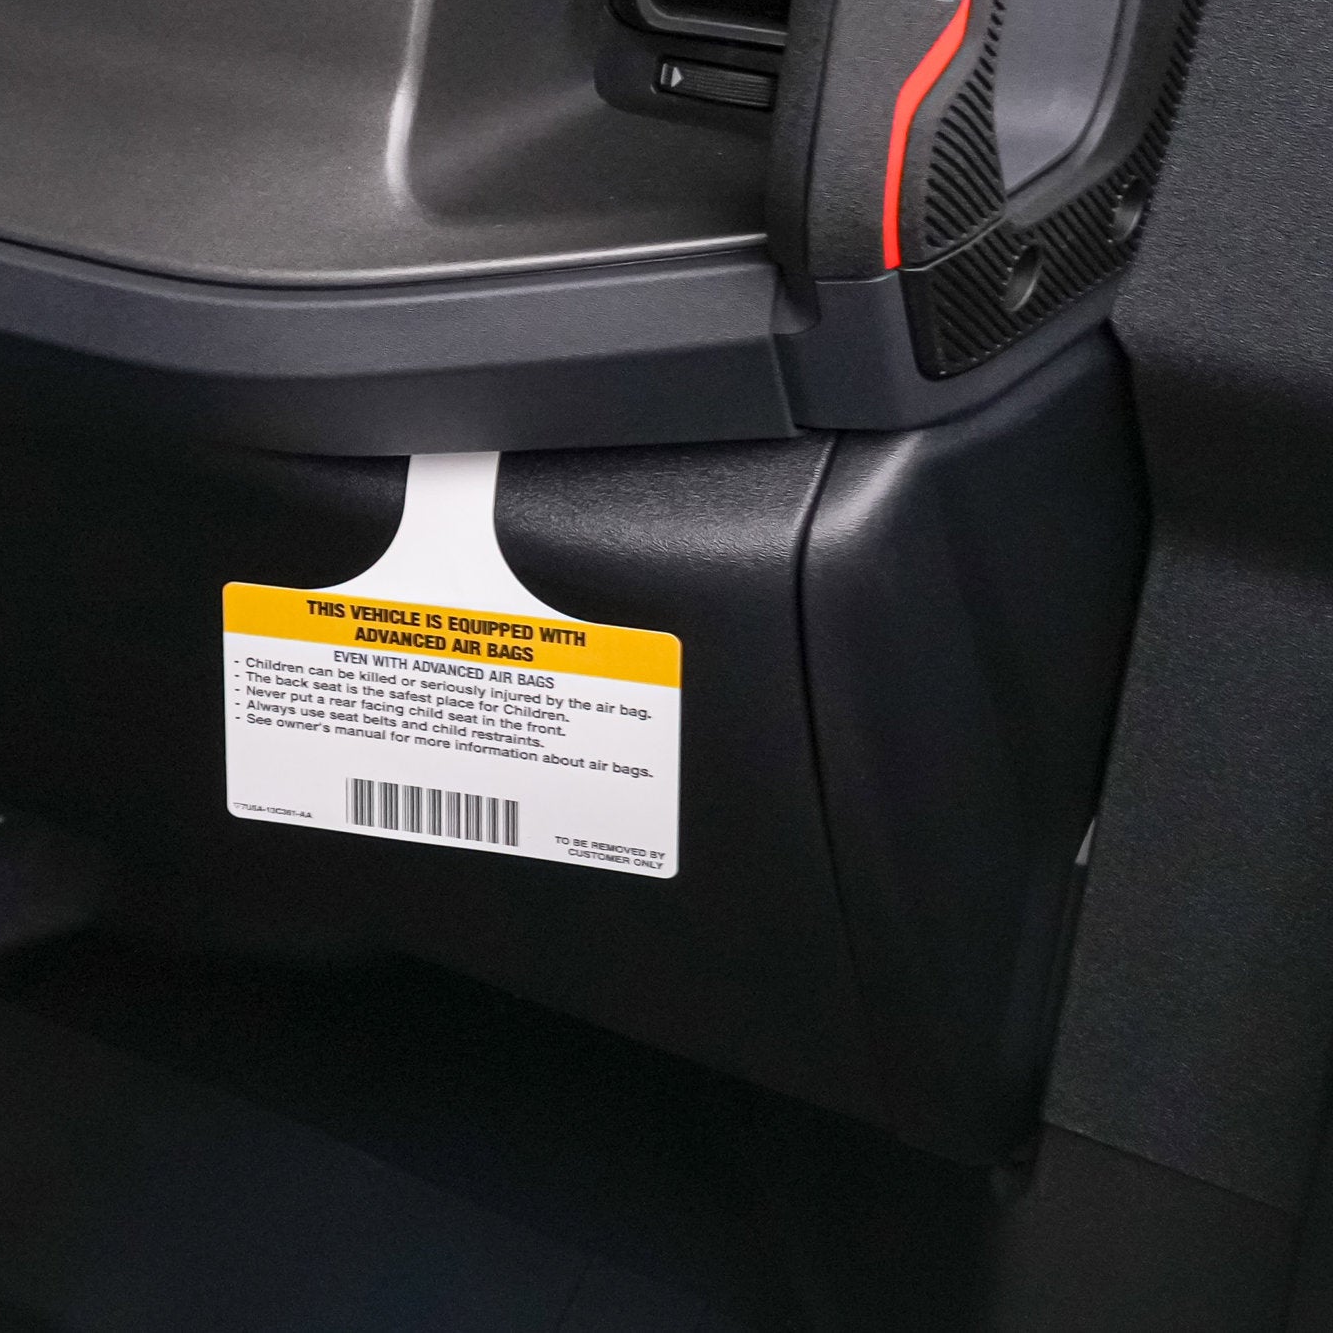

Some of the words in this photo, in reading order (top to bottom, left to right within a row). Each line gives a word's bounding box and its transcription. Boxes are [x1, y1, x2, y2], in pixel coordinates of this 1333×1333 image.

[307, 600, 346, 618] THIS
[351, 605, 420, 626] VEHICLE
[426, 614, 442, 629] IS
[448, 617, 533, 640] EQUIPPED
[540, 627, 586, 646] WITH
[355, 627, 446, 651] ADVANCED
[452, 639, 481, 656] AIR
[487, 643, 534, 662] BAGS
[246, 657, 303, 673] Children
[309, 666, 333, 677] can
[338, 670, 355, 679] be
[360, 671, 397, 684] killed
[401, 676, 416, 686] or
[421, 679, 486, 698] seriously
[491, 687, 541, 704] injured
[547, 695, 563, 709] by
[569, 698, 591, 710] the
[596, 702, 615, 714] air
[620, 705, 651, 720] bag.
[334, 651, 368, 665] EVEN
[373, 655, 407, 669] WITH
[413, 660, 483, 679] ADVANCED
[489, 670, 512, 684] AIR
[518, 674, 554, 689] BAGS
[247, 672, 271, 683] The
[276, 675, 308, 688] back
[313, 680, 342, 692] seat
[347, 683, 357, 694] is
[363, 685, 383, 697] the
[389, 689, 431, 703] safest
[436, 693, 474, 709] place
[479, 700, 498, 712] for
[504, 704, 570, 722] Children.
[247, 686, 286, 699] Never
[291, 692, 312, 703] put
[317, 696, 325, 704] a
[330, 698, 356, 708] rear
[361, 700, 404, 716] facing
[409, 706, 443, 719] child
[448, 712, 478, 725] seat
[483, 715, 495, 726] in
[500, 718, 522, 730] the
[527, 722, 566, 736] front.
[247, 700, 295, 715] Always
[301, 708, 325, 718] use
[330, 710, 358, 723] seat
[363, 714, 397, 727] belts
[401, 719, 427, 731] and
[433, 724, 466, 737] child
[472, 729, 544, 748] restraints.
[247, 714, 272, 725] See
[277, 719, 330, 732] owner's
[335, 725, 386, 740] manual
[391, 731, 409, 743] for
[415, 737, 450, 749] more
[455, 740, 537, 762] information
[543, 754, 584, 768] about
[589, 761, 608, 771] air
[613, 762, 653, 778] bags.
[555, 836, 569, 845] TO
[573, 839, 588, 847] BE
[592, 842, 646, 856] REMOVED
[650, 851, 665, 860] BY
[568, 849, 630, 864] CUSTOMER
[634, 859, 664, 869] ONLY
